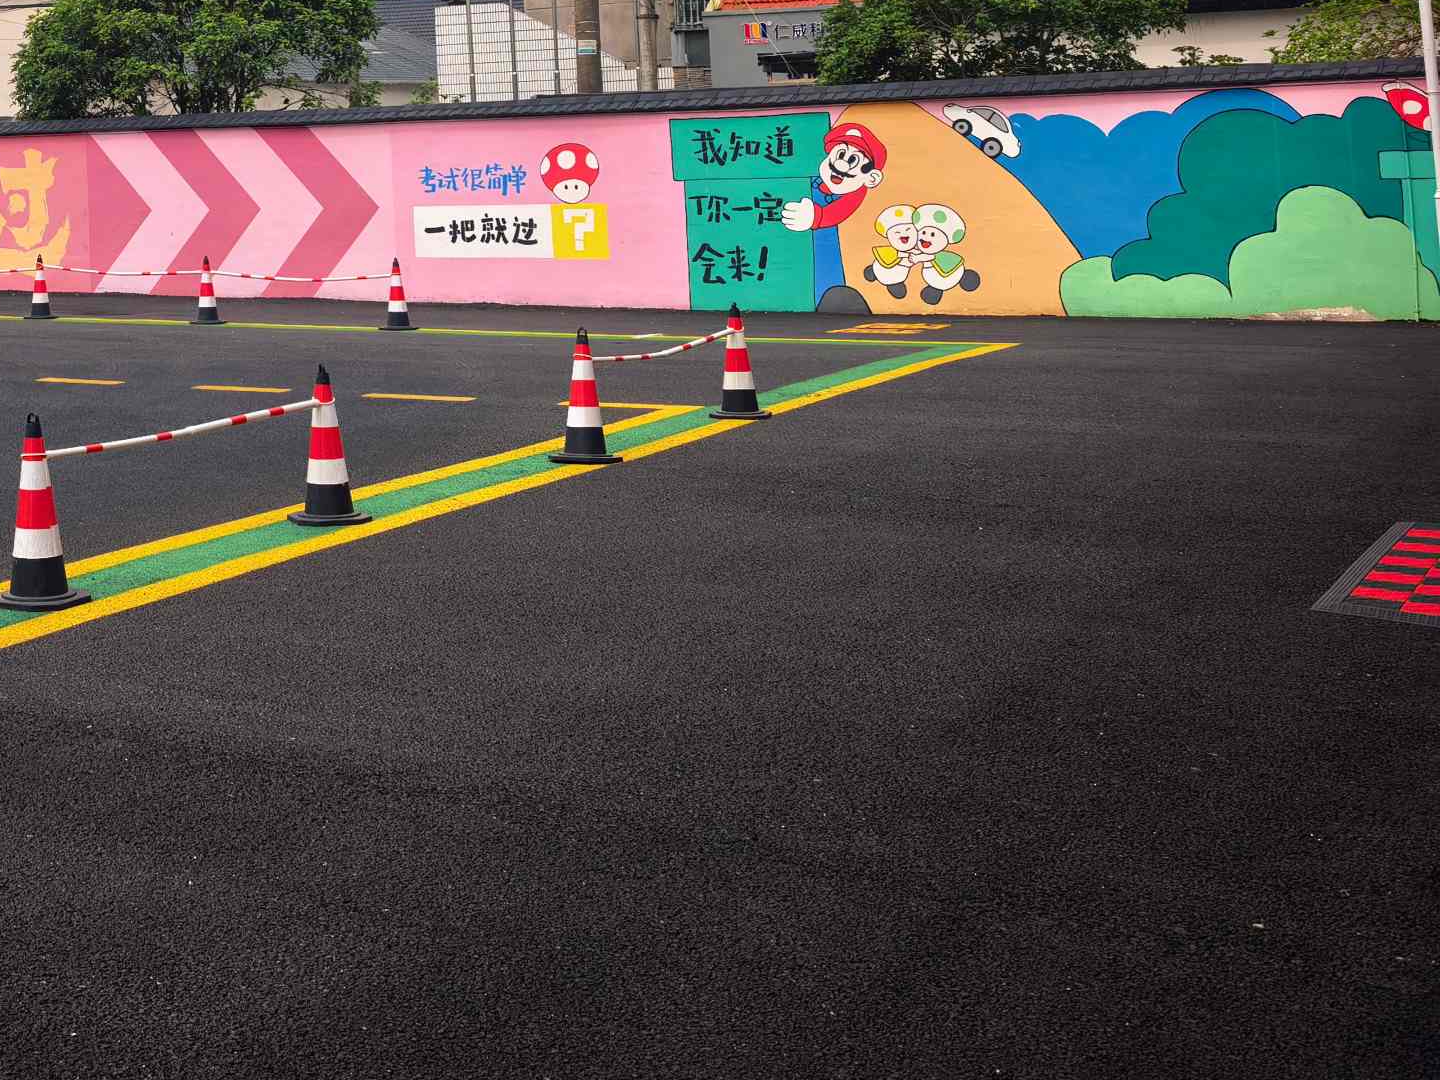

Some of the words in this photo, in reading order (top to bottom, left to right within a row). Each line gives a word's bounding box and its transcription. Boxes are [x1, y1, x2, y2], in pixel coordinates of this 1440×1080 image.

[691, 125, 794, 167] 我知道
[419, 163, 528, 197] 考试很简单
[688, 191, 784, 225] 你一定
[424, 212, 538, 246] 一把就过
[692, 243, 769, 284] 会来!
